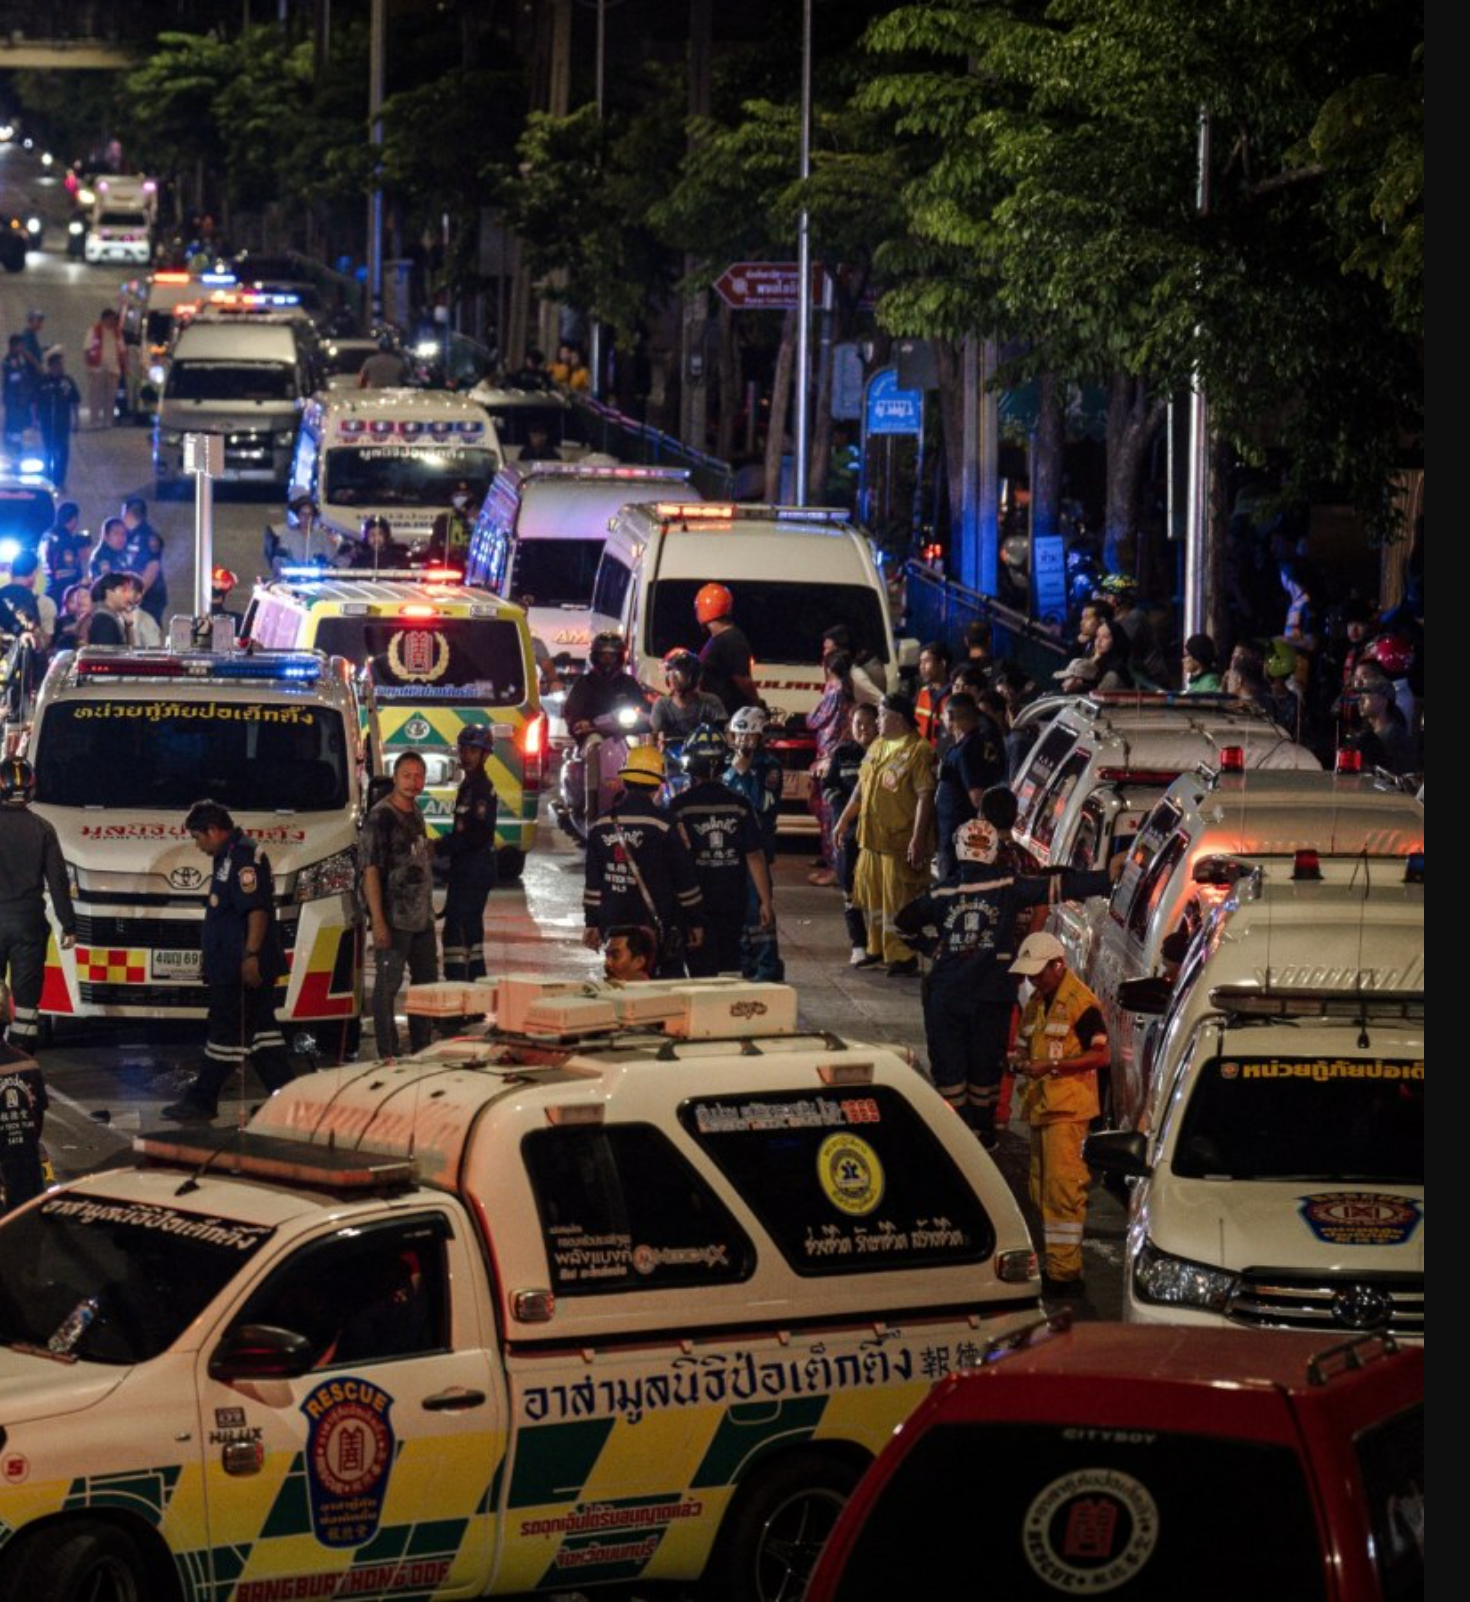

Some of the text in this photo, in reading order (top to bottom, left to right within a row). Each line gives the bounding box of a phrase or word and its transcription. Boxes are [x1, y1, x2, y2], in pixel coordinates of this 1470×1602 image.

[183, 952, 202, 966] 69
[524, 1330, 914, 1424] อาสามูลนิธิป่อเต็กตึ๊ง
[306, 1381, 388, 1419] RESCUE
[1062, 1428, 1157, 1445] CITYBOY
